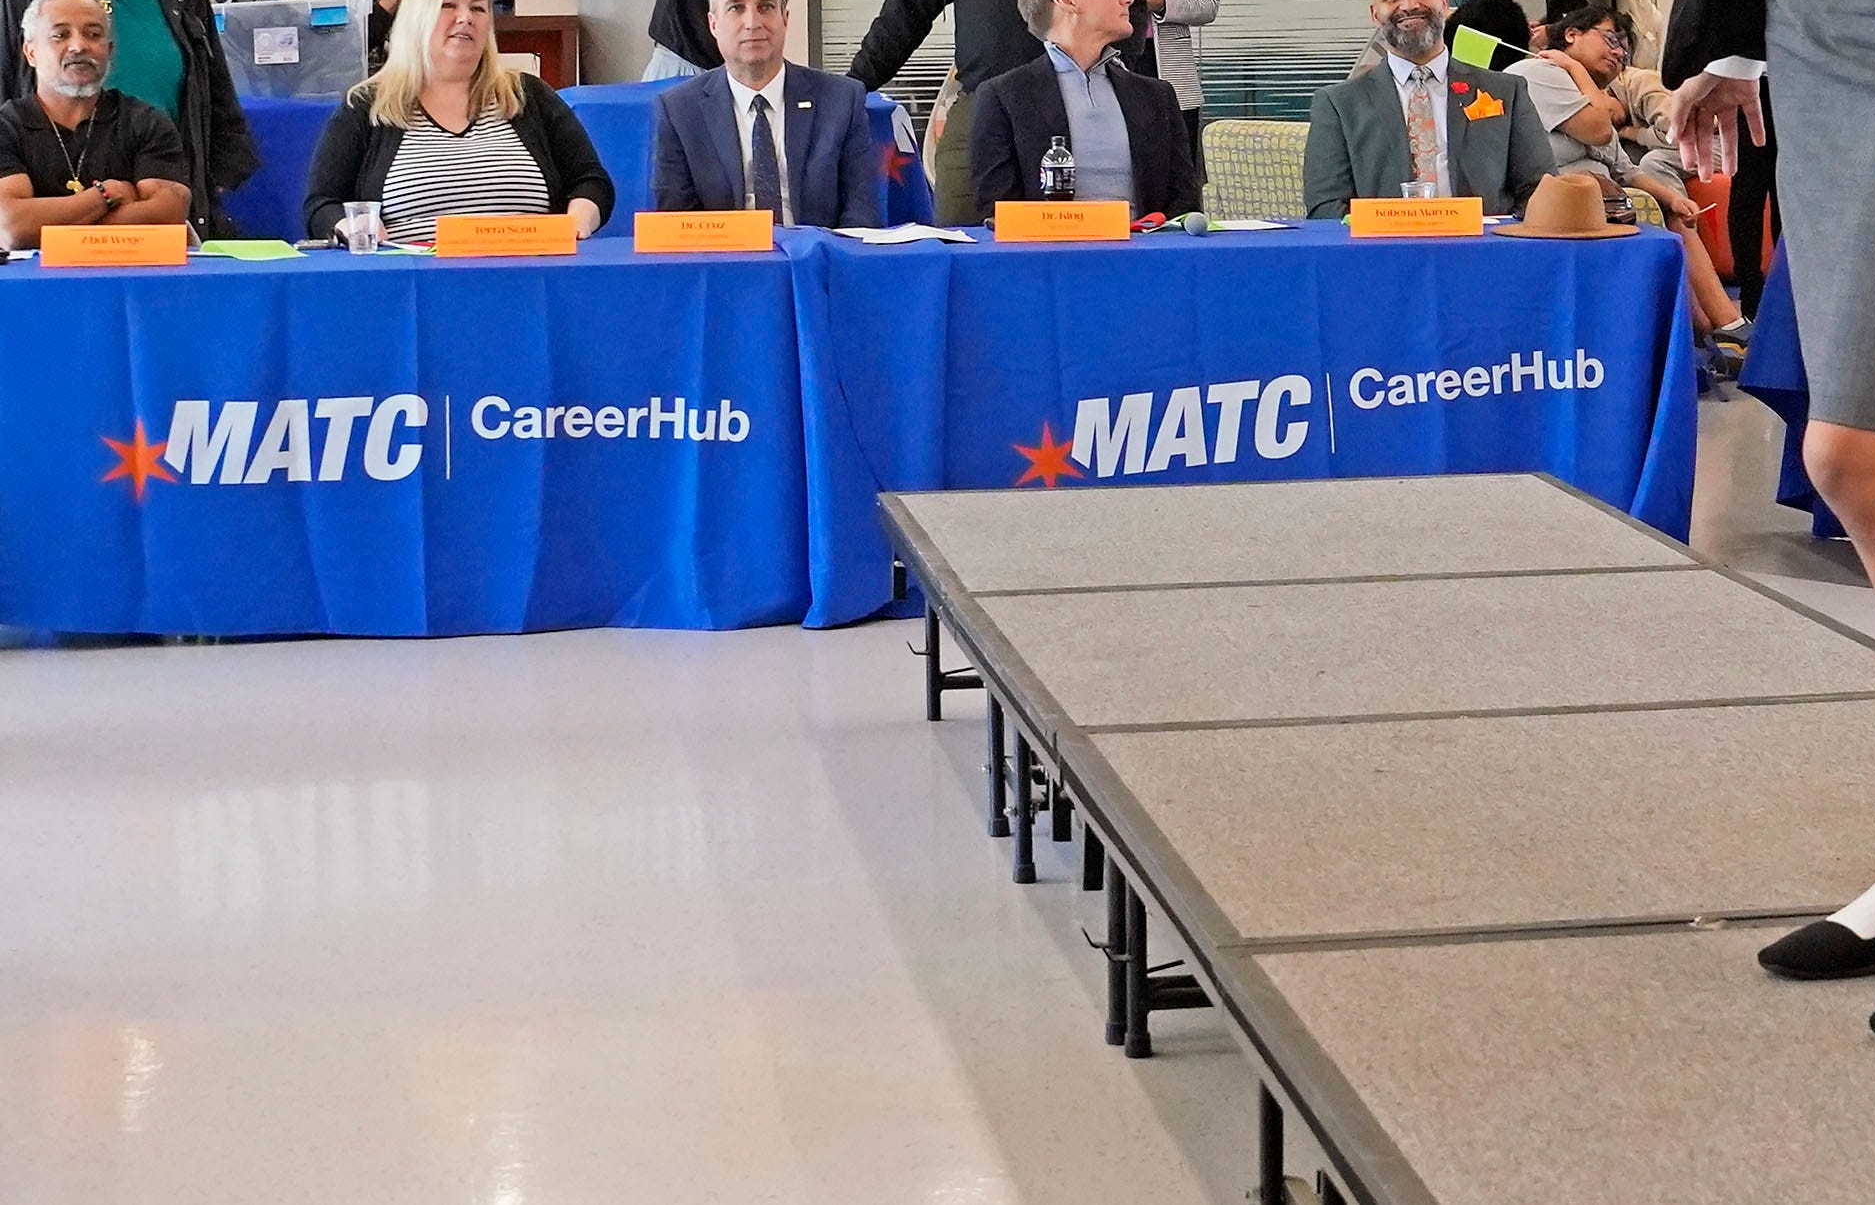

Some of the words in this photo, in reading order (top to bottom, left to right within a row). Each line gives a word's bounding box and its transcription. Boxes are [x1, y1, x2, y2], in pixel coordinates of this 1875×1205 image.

[1041, 211, 1057, 221] Dr.
[1058, 211, 1085, 223] King
[1419, 207, 1460, 217] Marcus
[698, 221, 726, 230] Cruz
[1071, 375, 1312, 478] MATC
[1350, 348, 1605, 410] CareerHub
[164, 394, 428, 485] MATC
[471, 395, 750, 443] CareerHub
